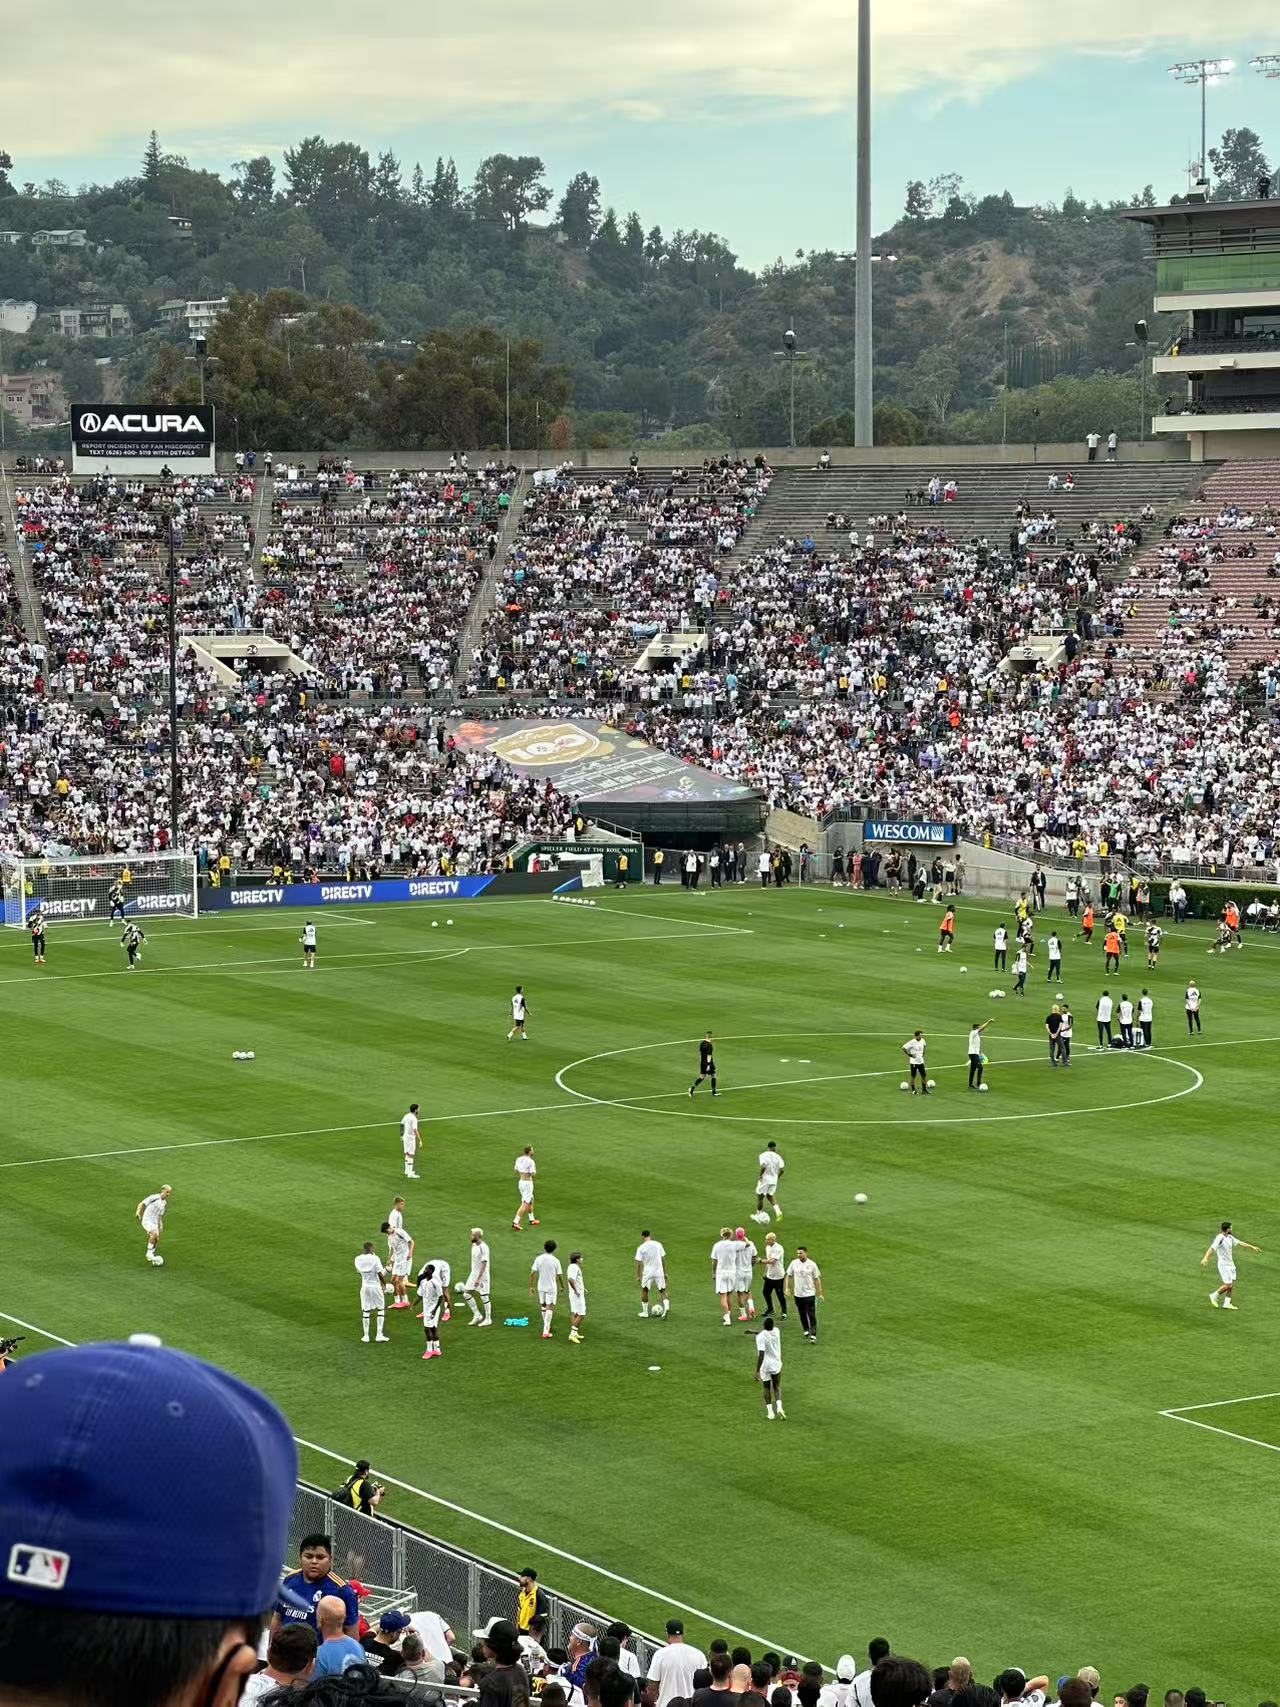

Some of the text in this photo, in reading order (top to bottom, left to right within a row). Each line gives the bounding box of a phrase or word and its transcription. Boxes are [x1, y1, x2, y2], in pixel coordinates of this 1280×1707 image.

[101, 414, 205, 432] ACURA
[247, 646, 258, 654] 24
[1023, 649, 1034, 657] 22
[872, 823, 930, 840] WESCOM
[321, 885, 372, 900] DIRECTV
[409, 880, 459, 895] DIRECTV
[137, 893, 191, 909] DIRECTV
[231, 889, 283, 904] DIRECTV
[39, 898, 96, 915] DIRECTV
